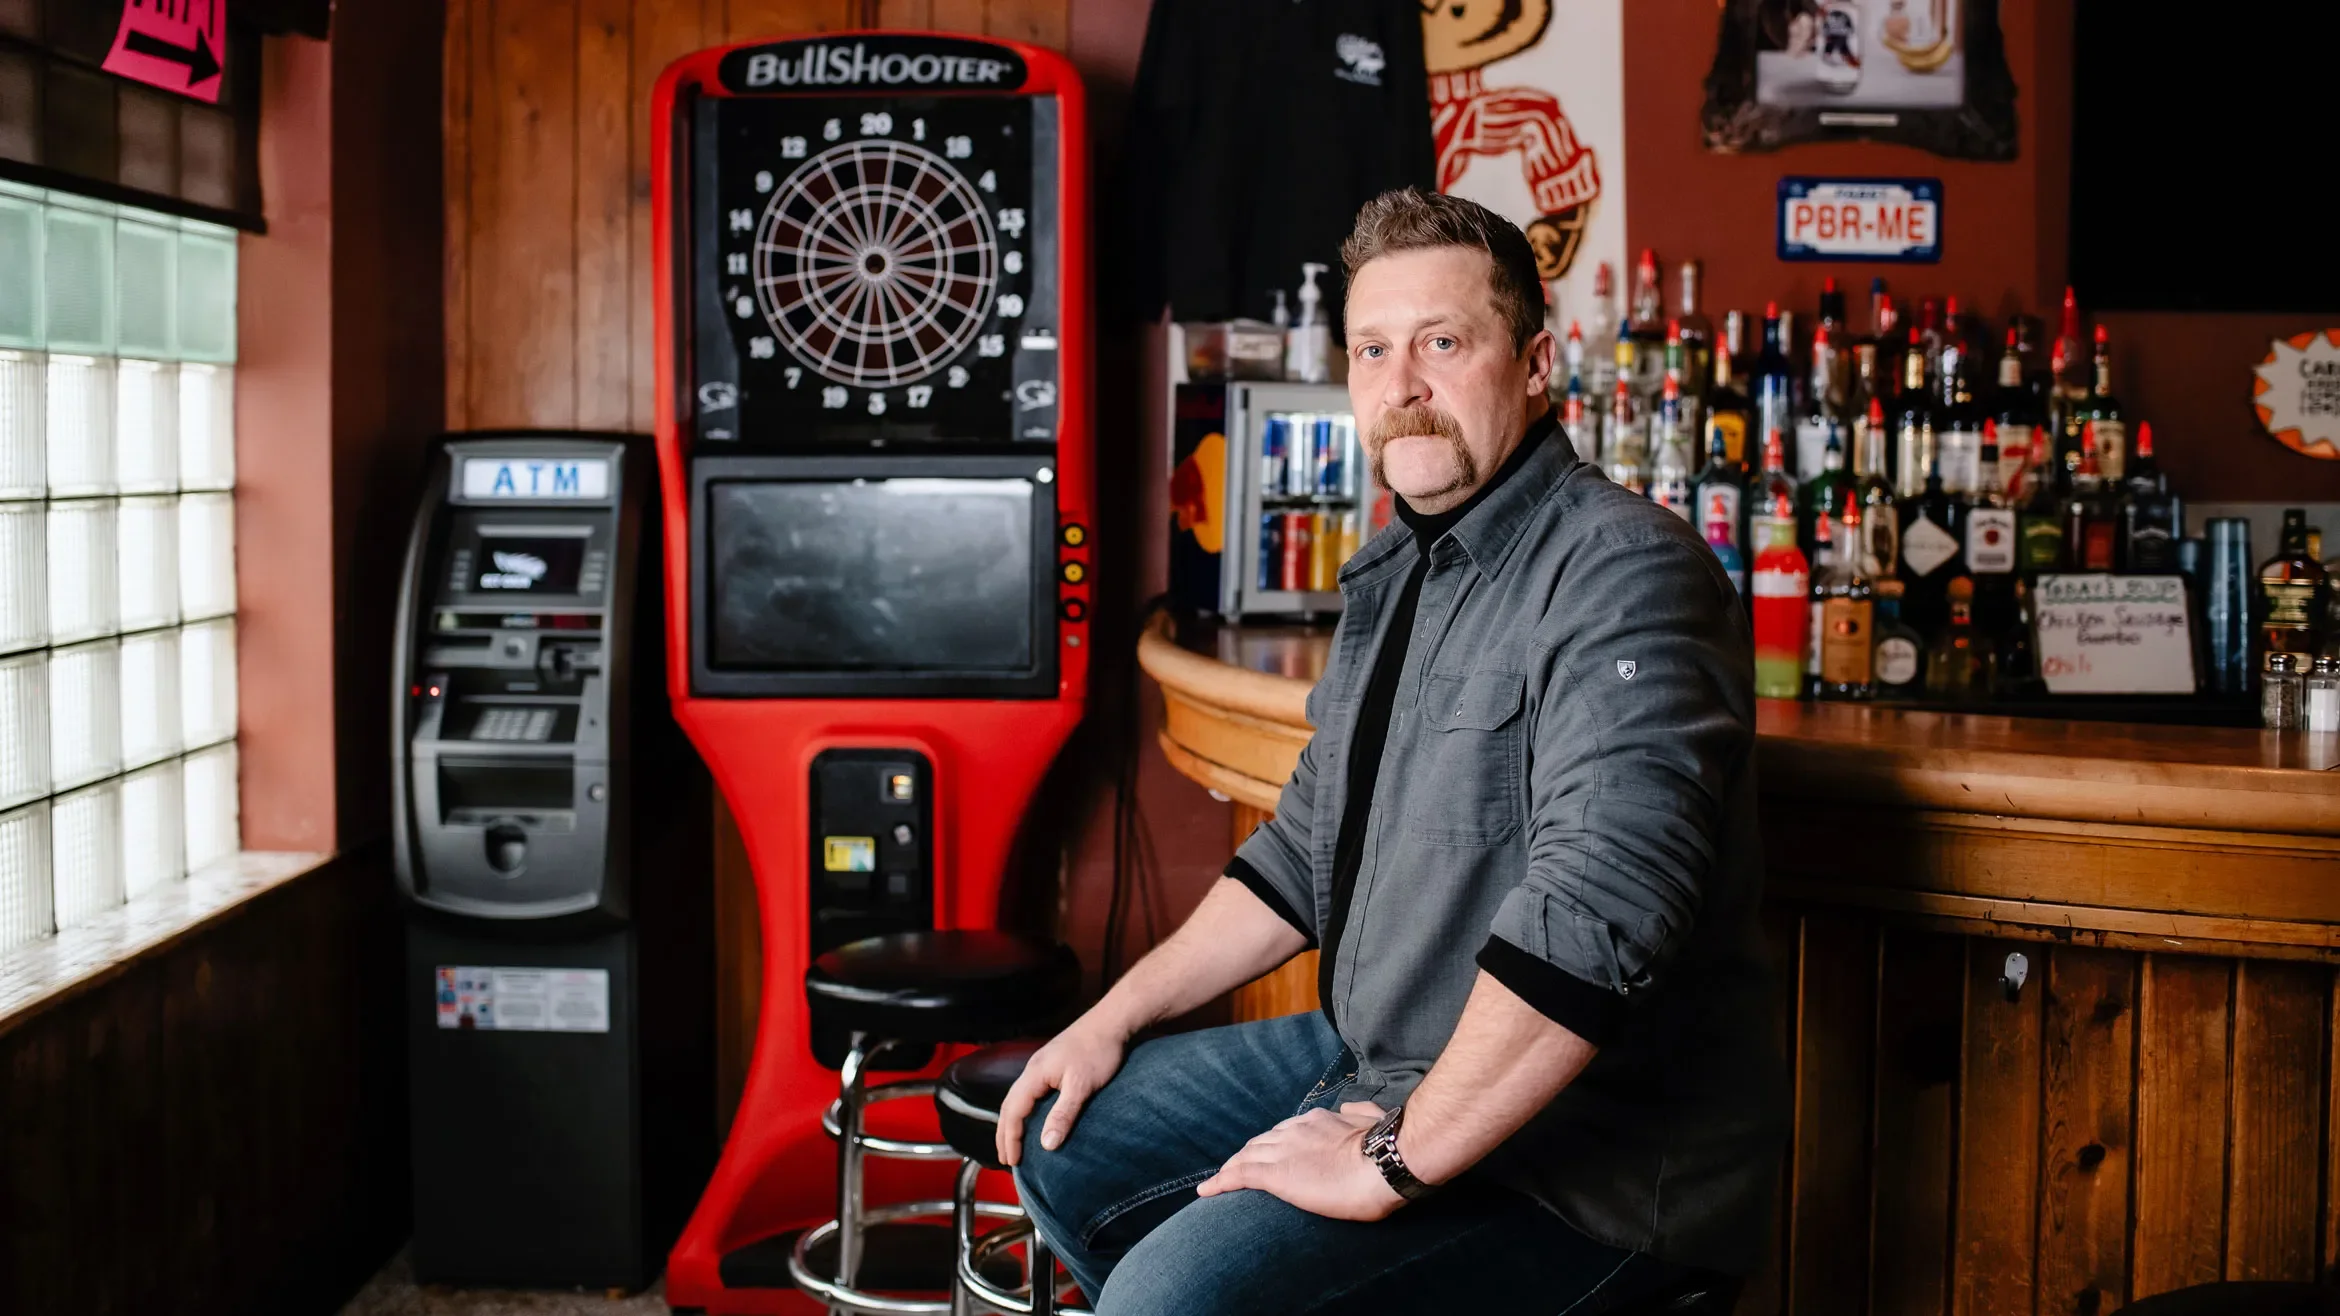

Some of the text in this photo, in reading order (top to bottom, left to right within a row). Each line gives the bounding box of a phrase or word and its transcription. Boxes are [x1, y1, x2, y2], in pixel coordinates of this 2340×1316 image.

[823, 119, 841, 141] 5
[860, 112, 893, 136] 20
[913, 119, 925, 141] 1
[780, 136, 807, 158] 12
[945, 136, 972, 158] 18
[755, 171, 773, 193] 9
[979, 171, 996, 192] 4
[729, 209, 753, 231] 14
[1795, 204, 1924, 241] PBR-ME
[727, 253, 747, 275] 11
[1003, 253, 1023, 275] 6
[735, 297, 754, 318] 8
[997, 296, 1023, 317] 10
[750, 337, 775, 359] 16
[979, 337, 1004, 358] 15
[784, 368, 801, 389] 7
[949, 366, 969, 388] 2
[823, 387, 848, 408] 19
[869, 393, 886, 415] 3
[908, 386, 932, 408] 17
[493, 463, 581, 495] ATM
